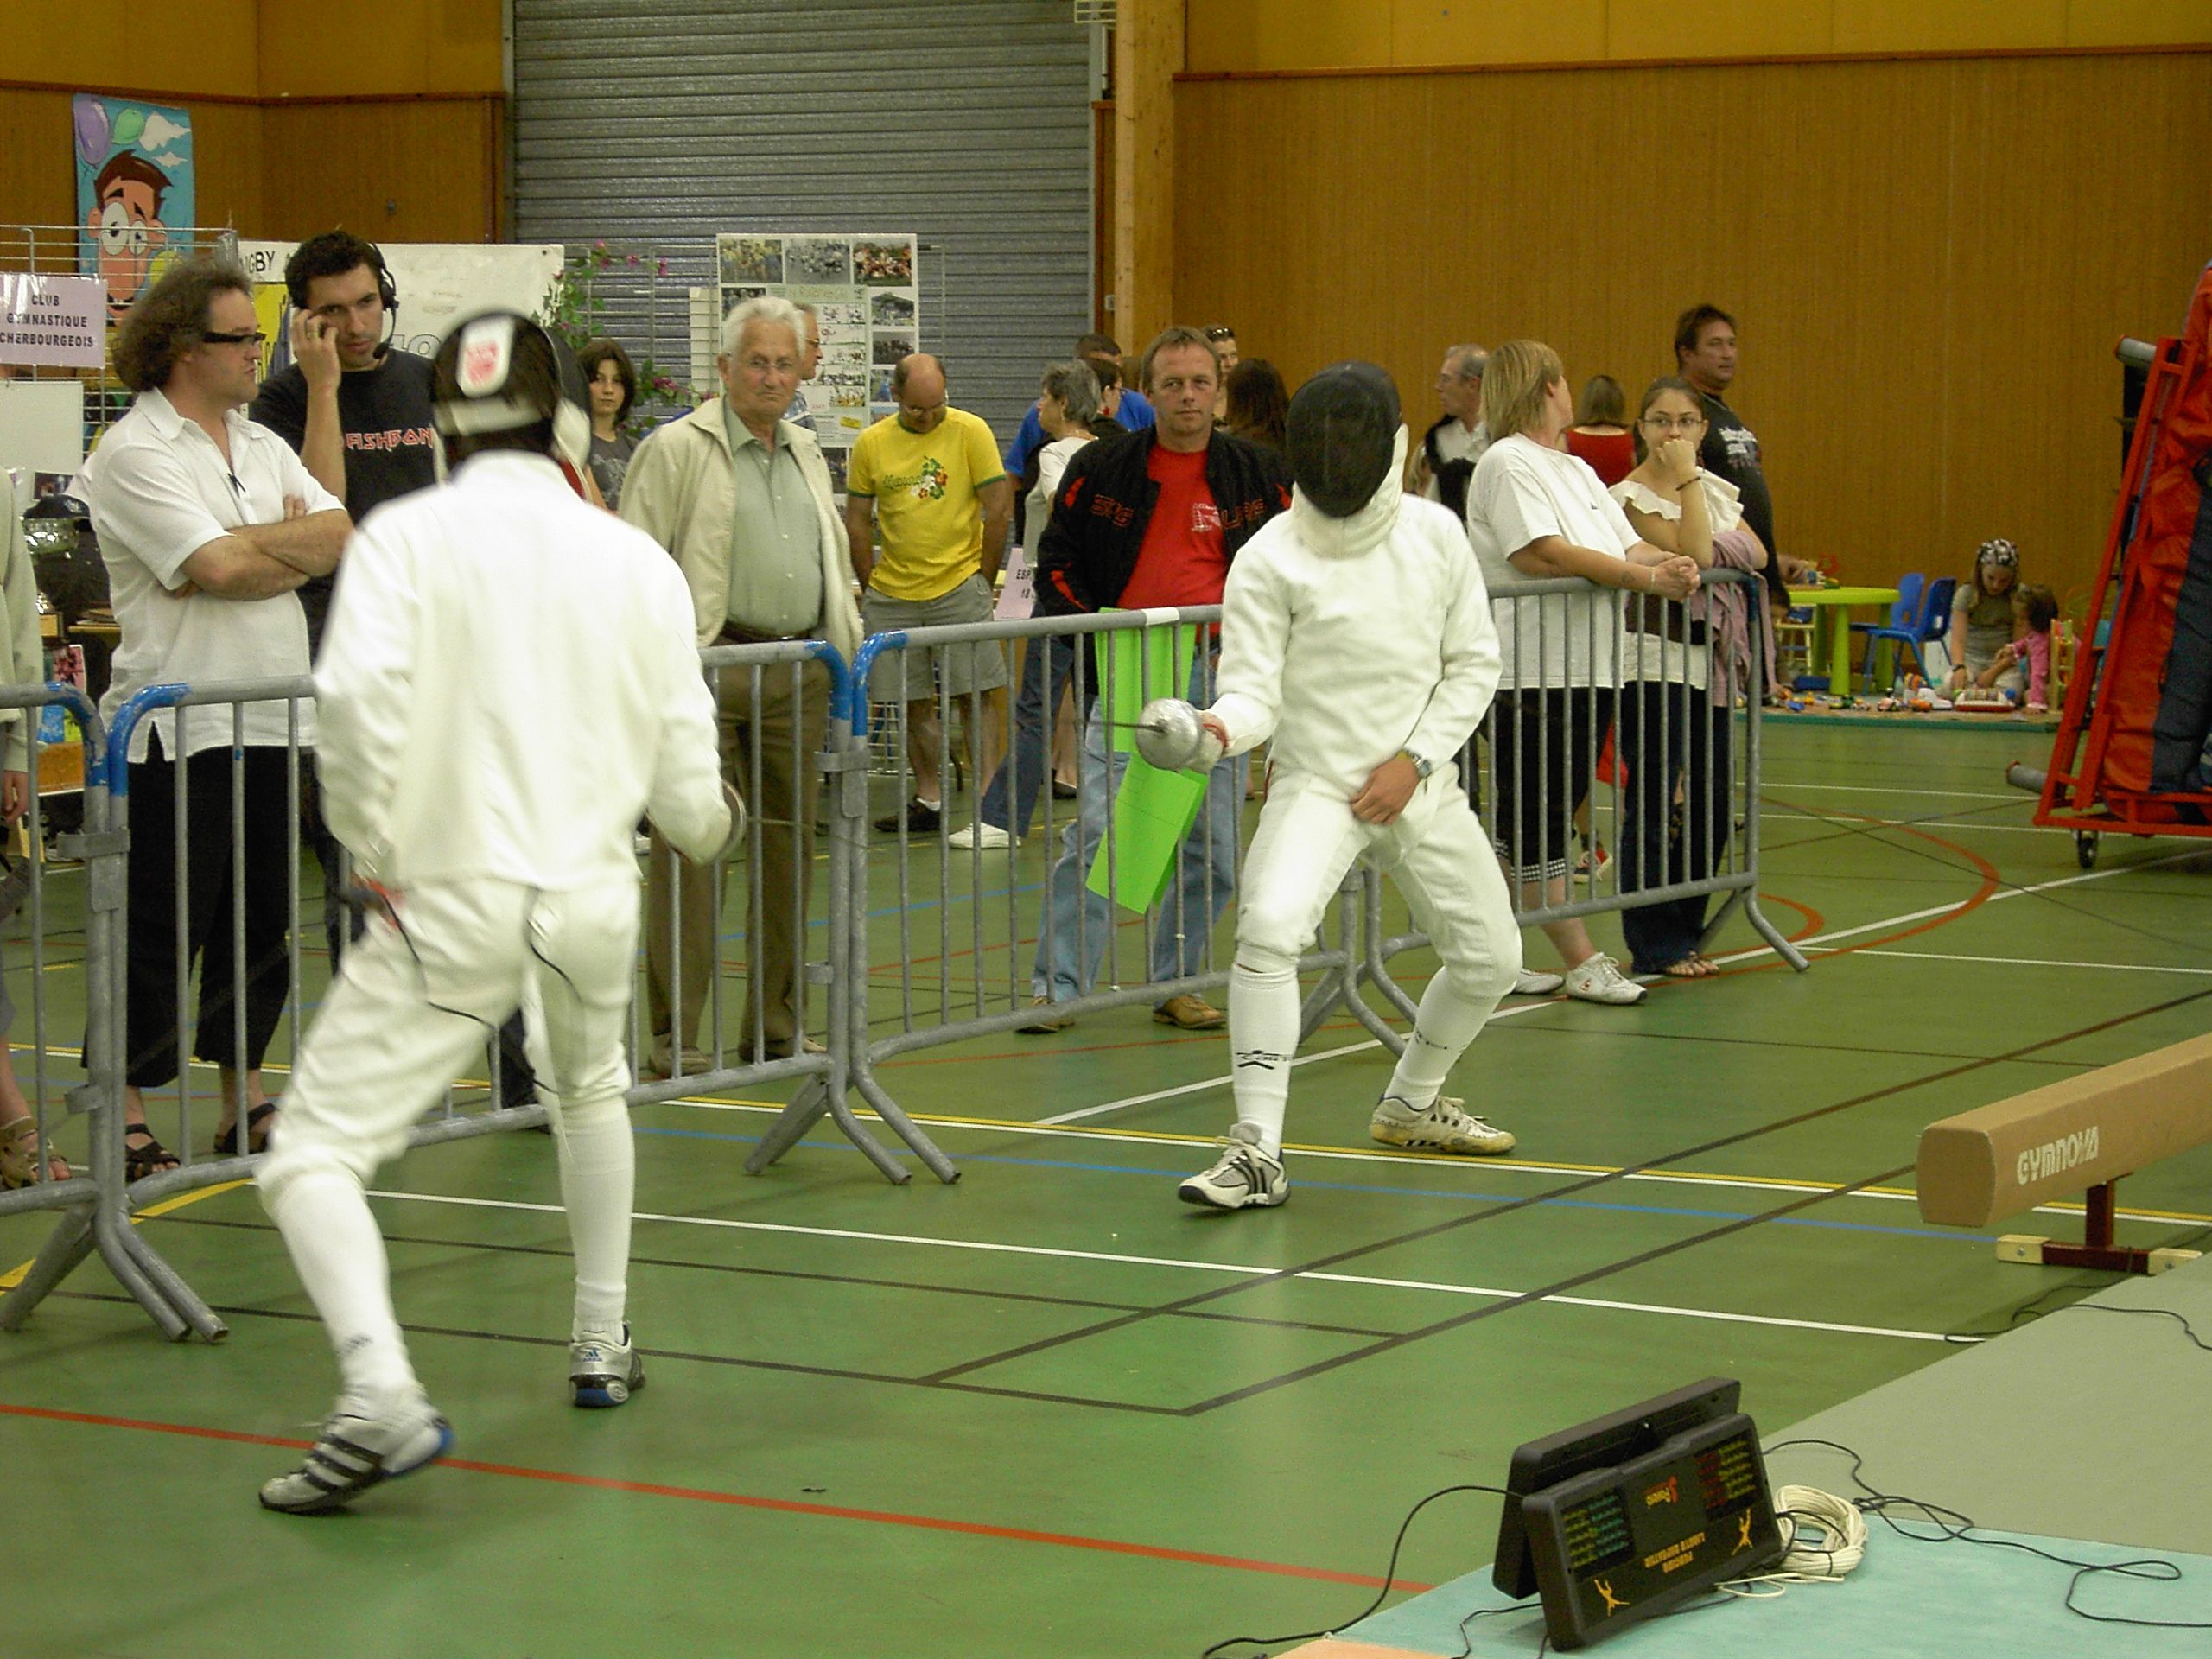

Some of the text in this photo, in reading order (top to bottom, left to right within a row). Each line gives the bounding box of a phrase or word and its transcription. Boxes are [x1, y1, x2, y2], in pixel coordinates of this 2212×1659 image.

[31, 295, 60, 306] CLUB
[0, 332, 94, 347] CHERBOURGEOIS
[346, 428, 434, 452] FISHBON
[2017, 1126, 2099, 1185] GYMNOVA
